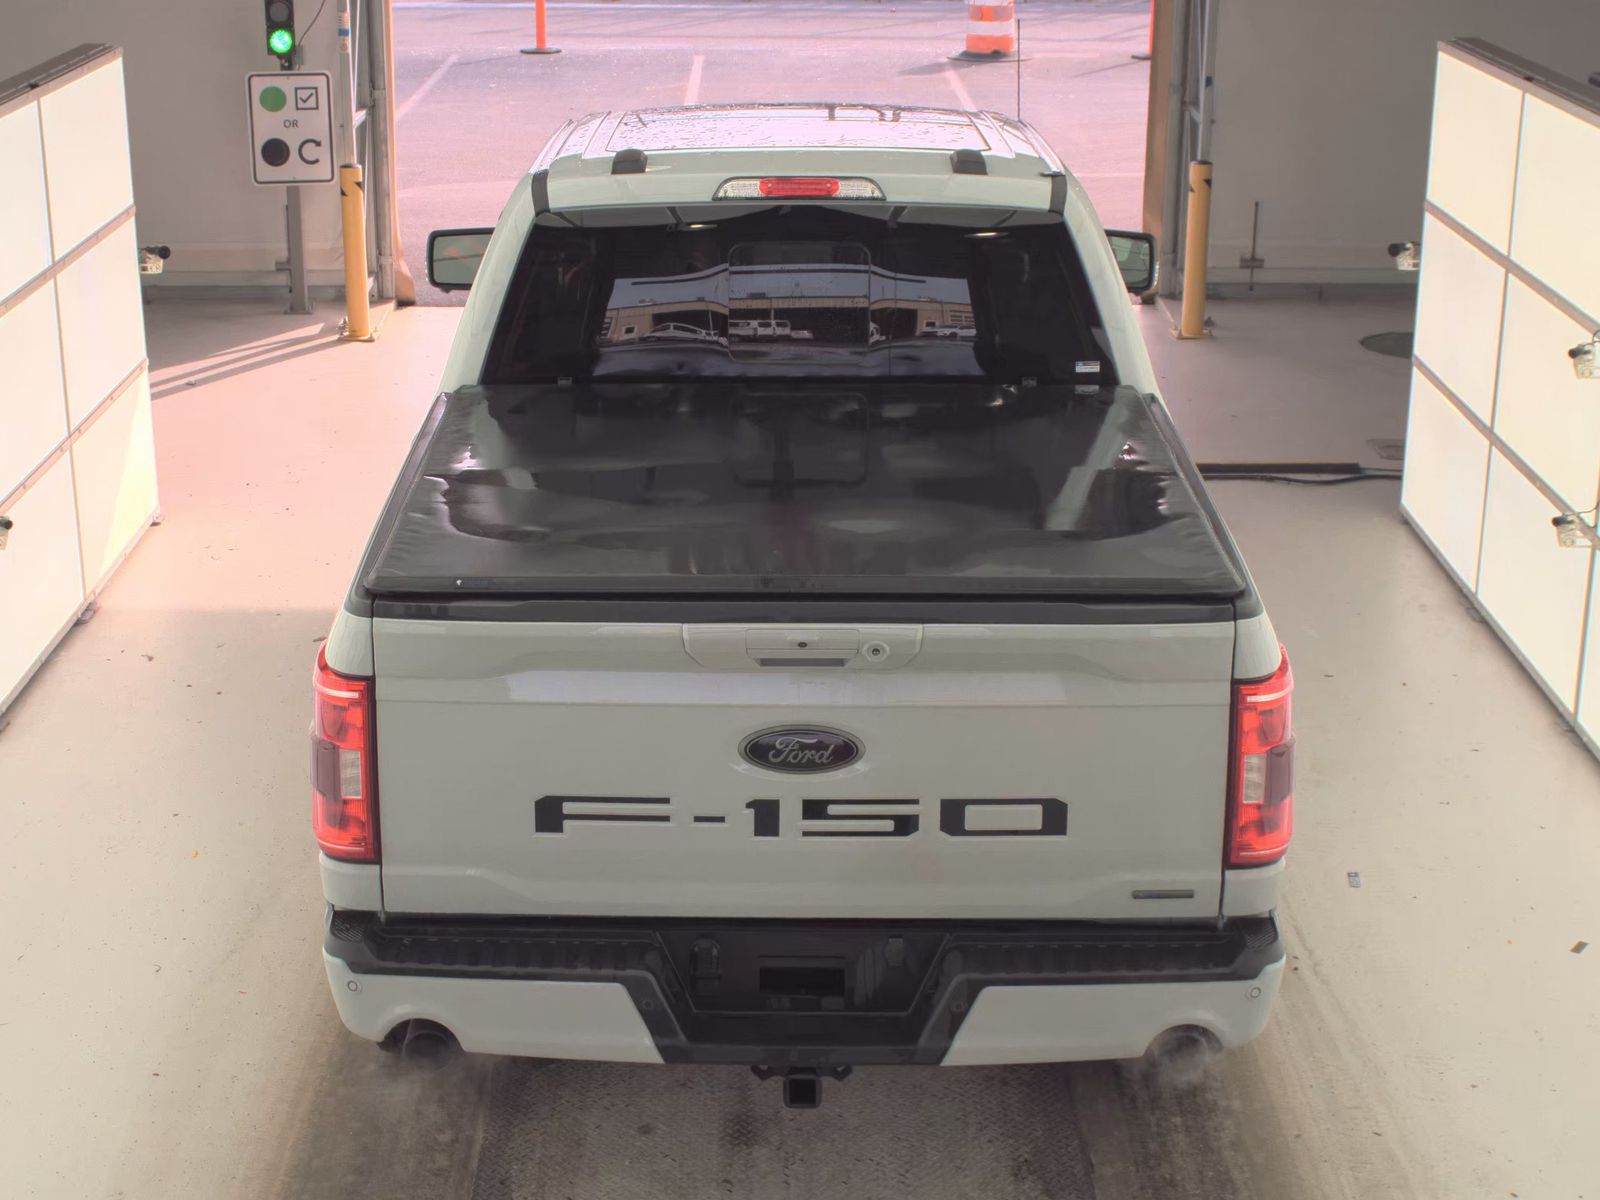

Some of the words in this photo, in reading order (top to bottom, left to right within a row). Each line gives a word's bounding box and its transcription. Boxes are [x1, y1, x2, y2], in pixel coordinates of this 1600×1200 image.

[283, 119, 299, 129] OR
[768, 736, 834, 763] Ford
[535, 795, 1067, 837] F-150
